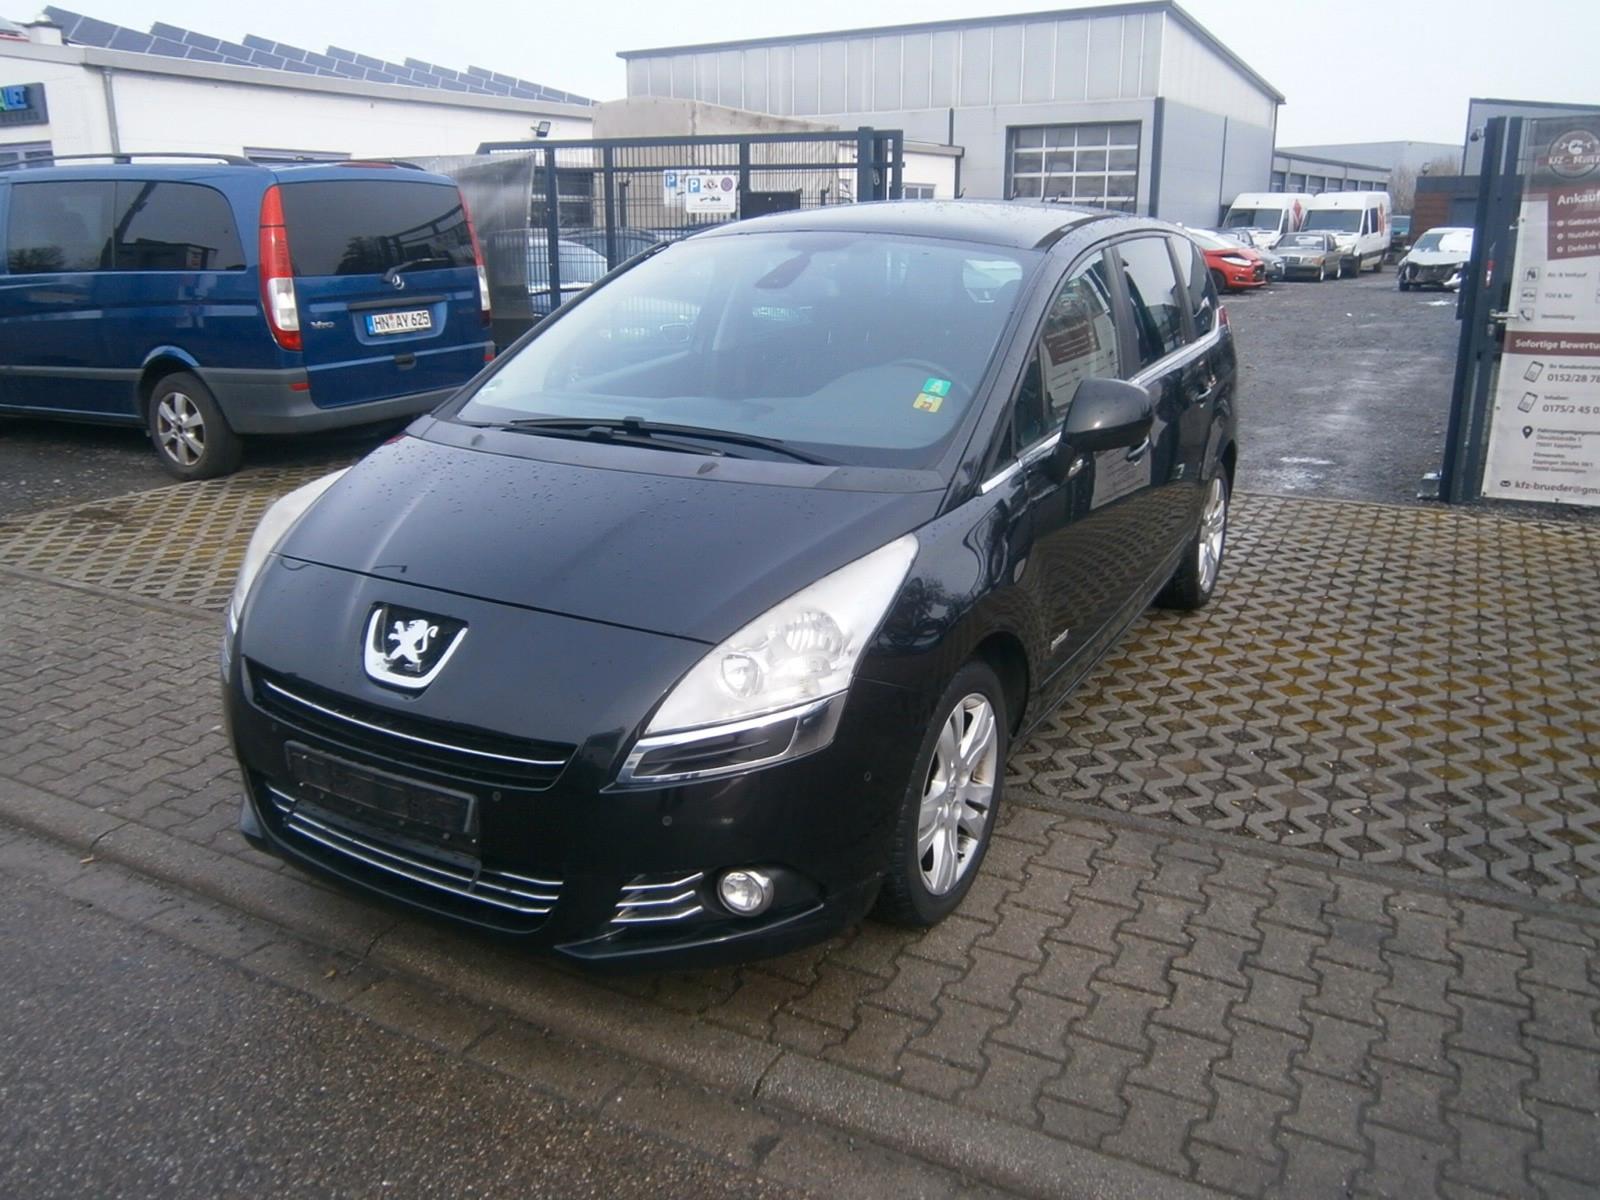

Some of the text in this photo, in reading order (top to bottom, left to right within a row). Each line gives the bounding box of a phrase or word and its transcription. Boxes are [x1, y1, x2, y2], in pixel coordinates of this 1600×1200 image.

[374, 311, 429, 331] HN AY 625
[1515, 339, 1559, 352] Sofortige
[1547, 373, 1588, 384] 0152/28
[1542, 404, 1576, 414] 0175/2
[1578, 406, 1590, 415] 45
